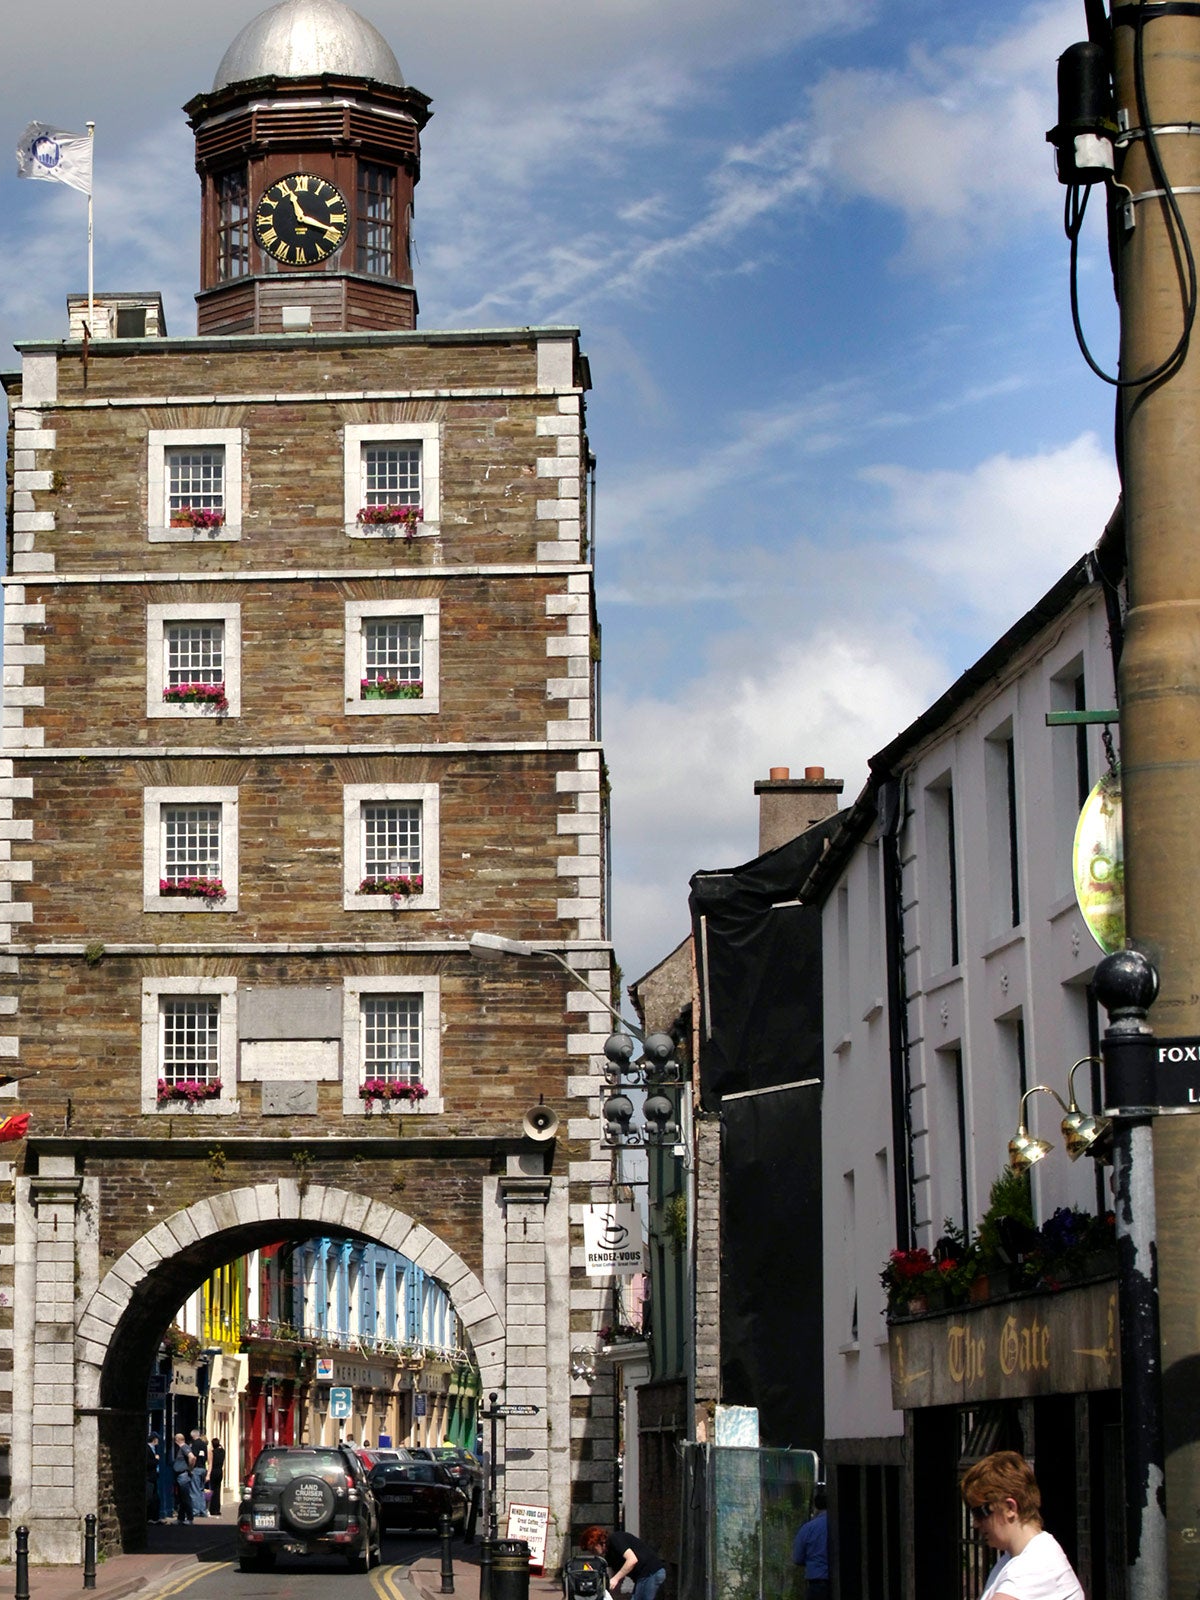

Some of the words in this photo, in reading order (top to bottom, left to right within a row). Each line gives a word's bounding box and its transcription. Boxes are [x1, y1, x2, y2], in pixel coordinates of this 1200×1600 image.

[1159, 1047, 1200, 1062] FOX
[588, 1252, 641, 1262] RENDEZ-VOUS
[947, 1326, 986, 1388] The
[1000, 1315, 1050, 1376] Gate
[335, 1401, 347, 1415] P
